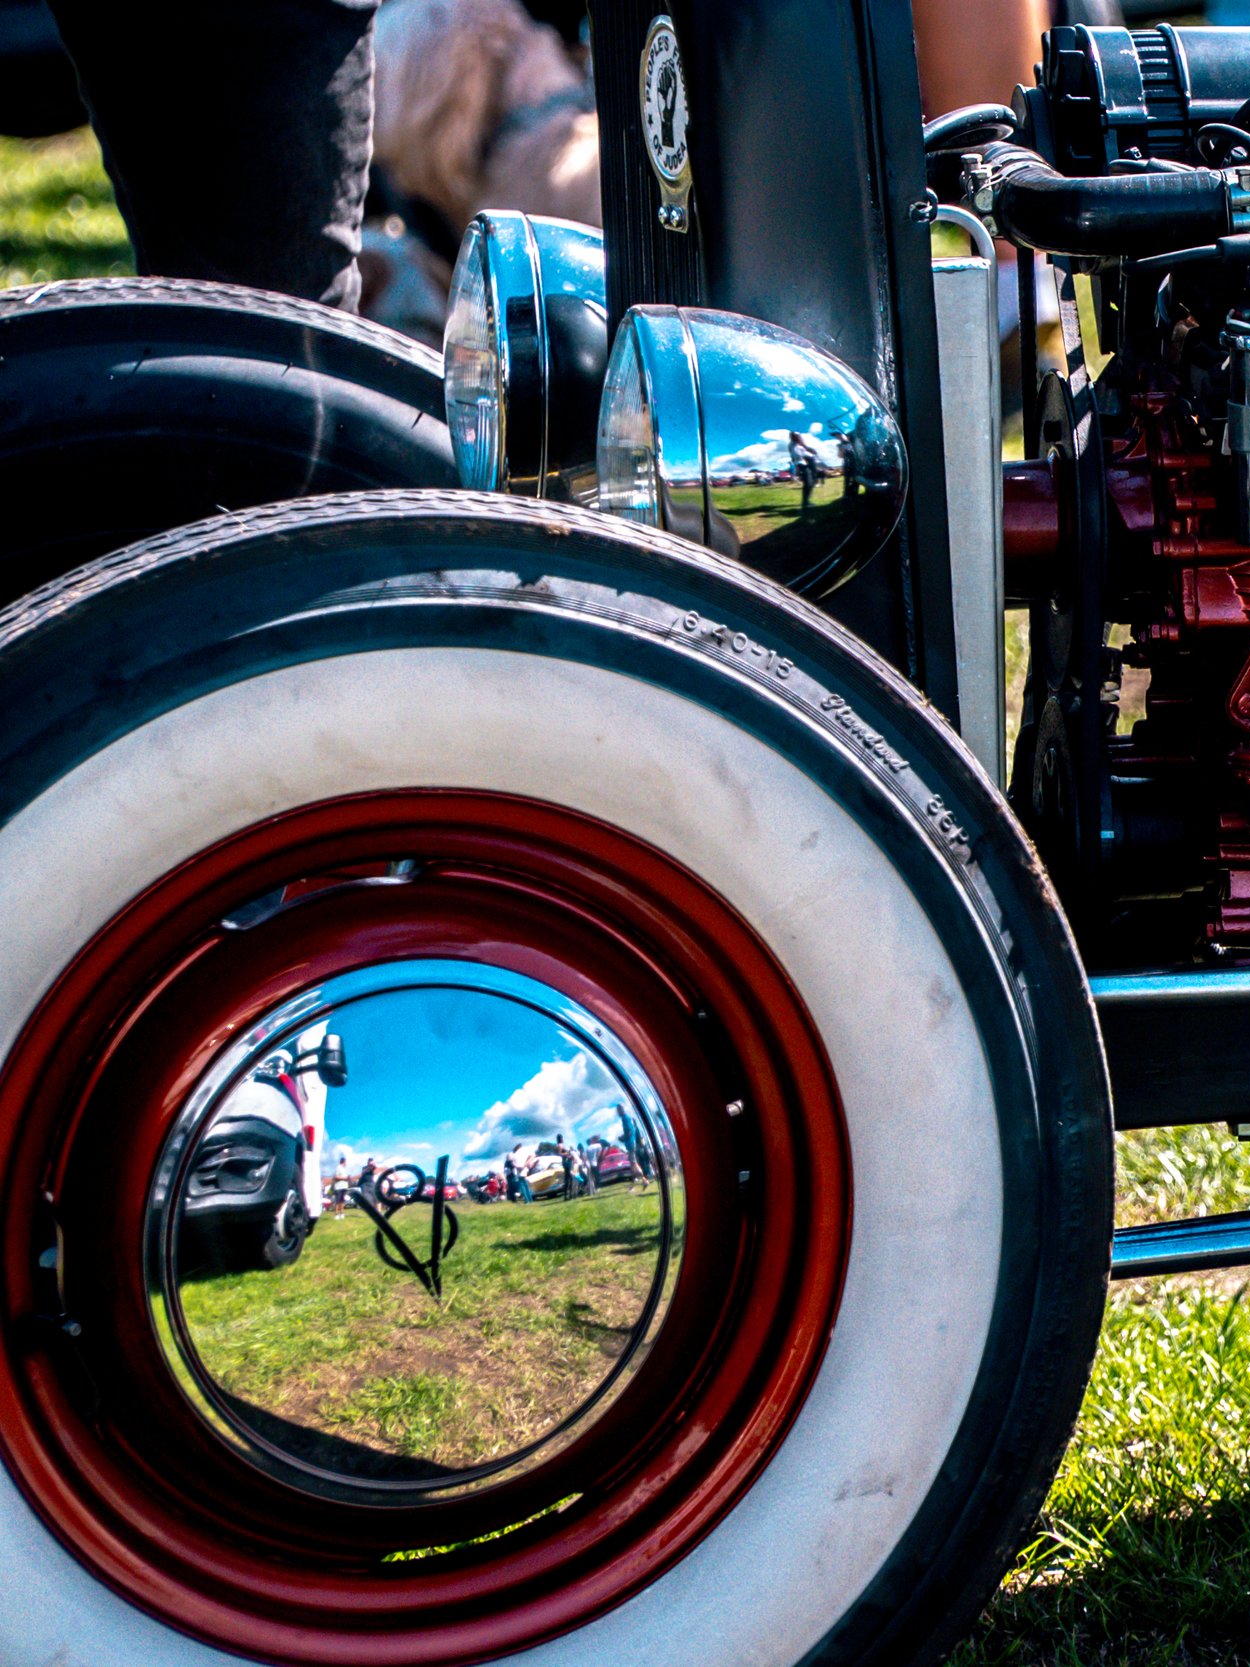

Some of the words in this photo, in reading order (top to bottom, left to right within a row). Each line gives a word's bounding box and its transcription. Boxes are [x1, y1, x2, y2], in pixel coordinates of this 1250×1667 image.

[653, 134, 663, 156] OF
[663, 141, 686, 170] JUDEA
[684, 610, 794, 679] 6.40-15
